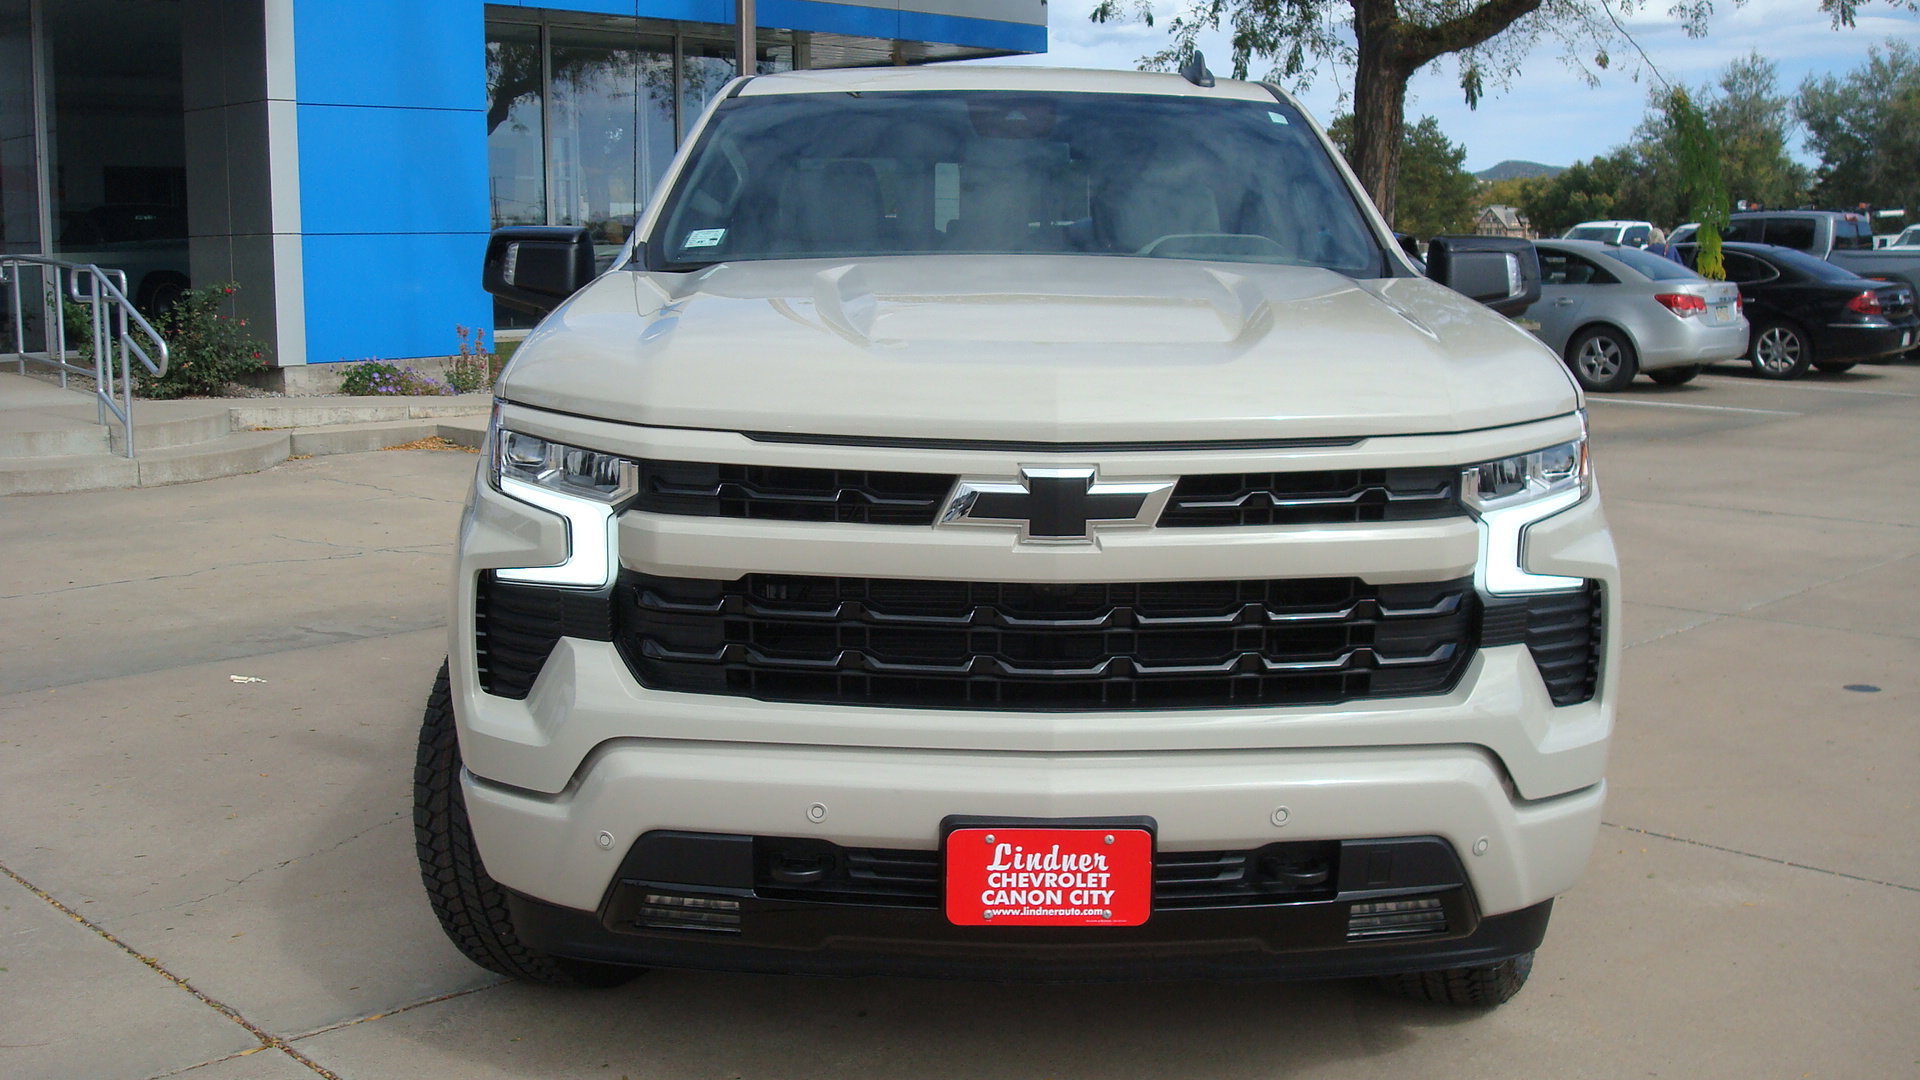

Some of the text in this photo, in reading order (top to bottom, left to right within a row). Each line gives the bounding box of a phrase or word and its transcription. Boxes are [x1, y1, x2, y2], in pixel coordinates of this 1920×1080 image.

[986, 843, 1109, 872] Lindner
[987, 873, 1111, 888] CHEVROLET
[981, 889, 1115, 905] CANON CITY
[992, 906, 1103, 917] www.lindnerauto.com
